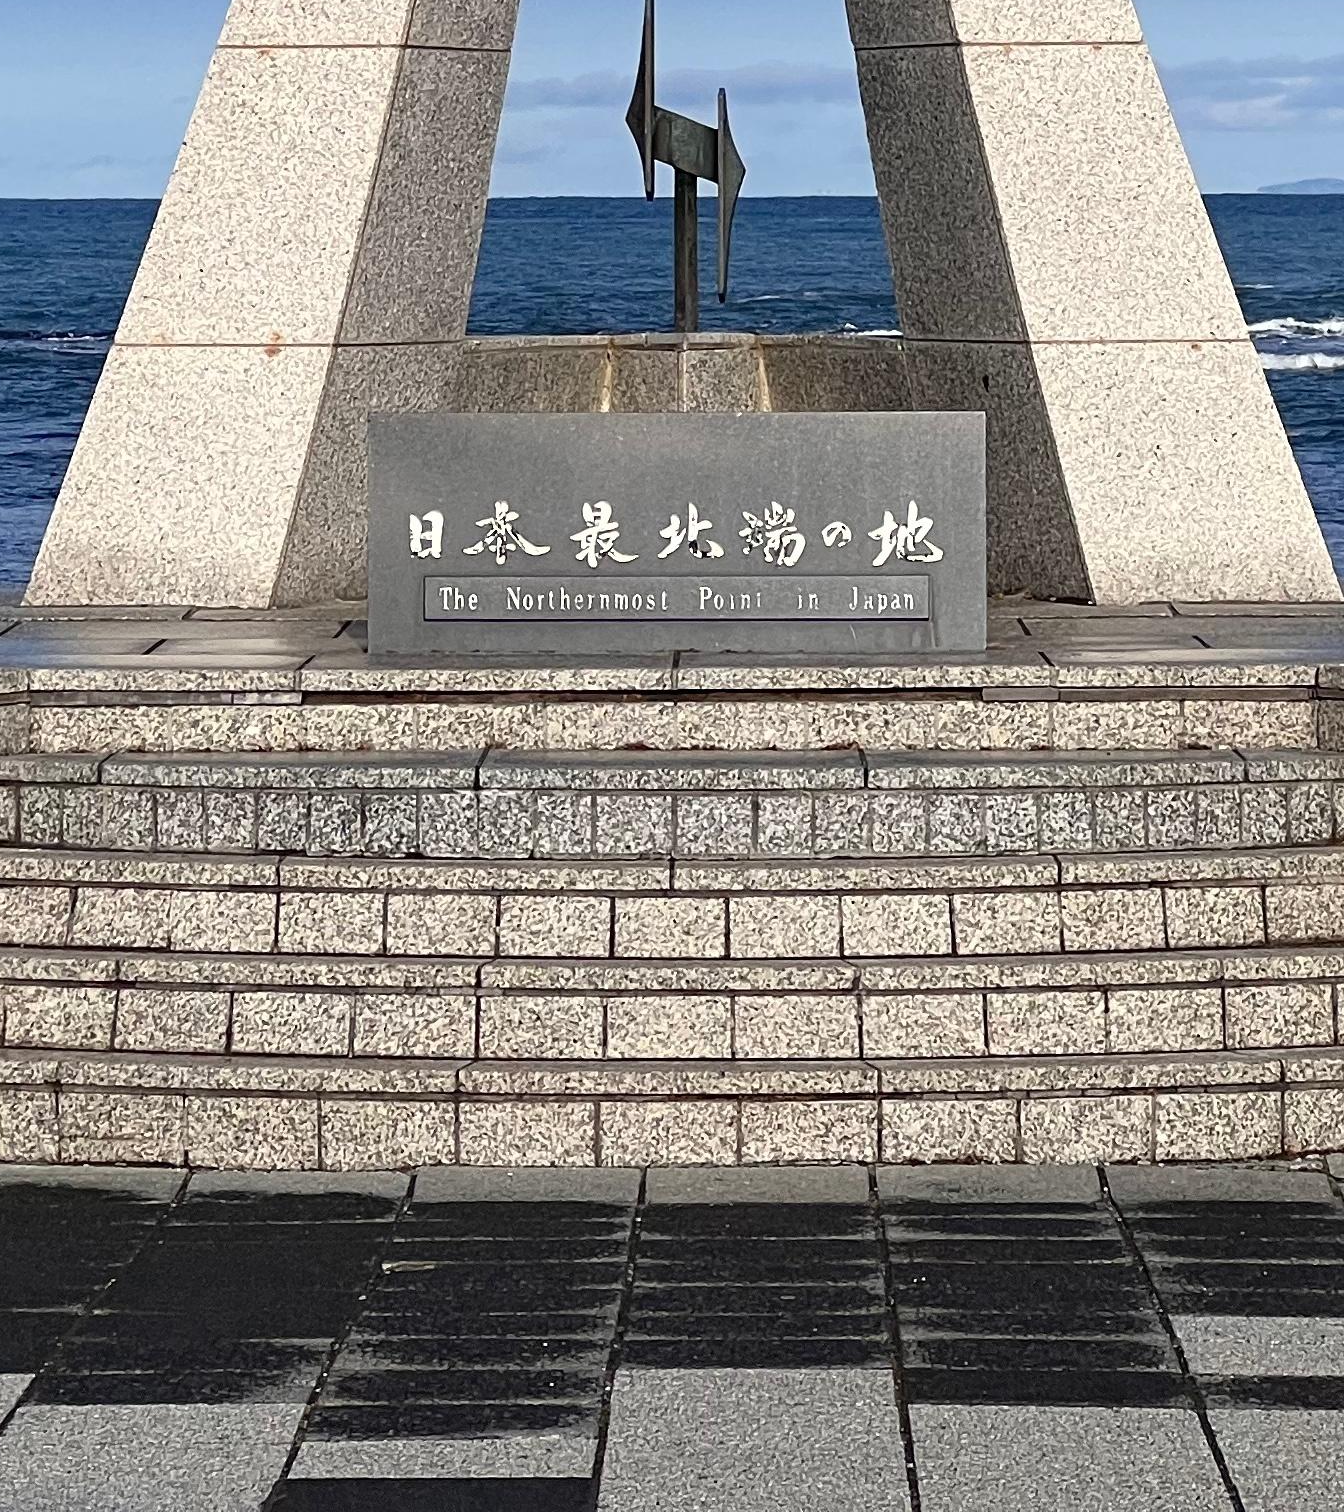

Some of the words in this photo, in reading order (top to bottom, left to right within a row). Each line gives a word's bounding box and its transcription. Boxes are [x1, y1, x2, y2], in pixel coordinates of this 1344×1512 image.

[409, 500, 944, 568] 日本最北端の地
[439, 586, 479, 611] The
[506, 586, 669, 611] Northernmost
[699, 586, 762, 611] Point
[796, 587, 819, 610] in
[849, 586, 915, 614] Japan
